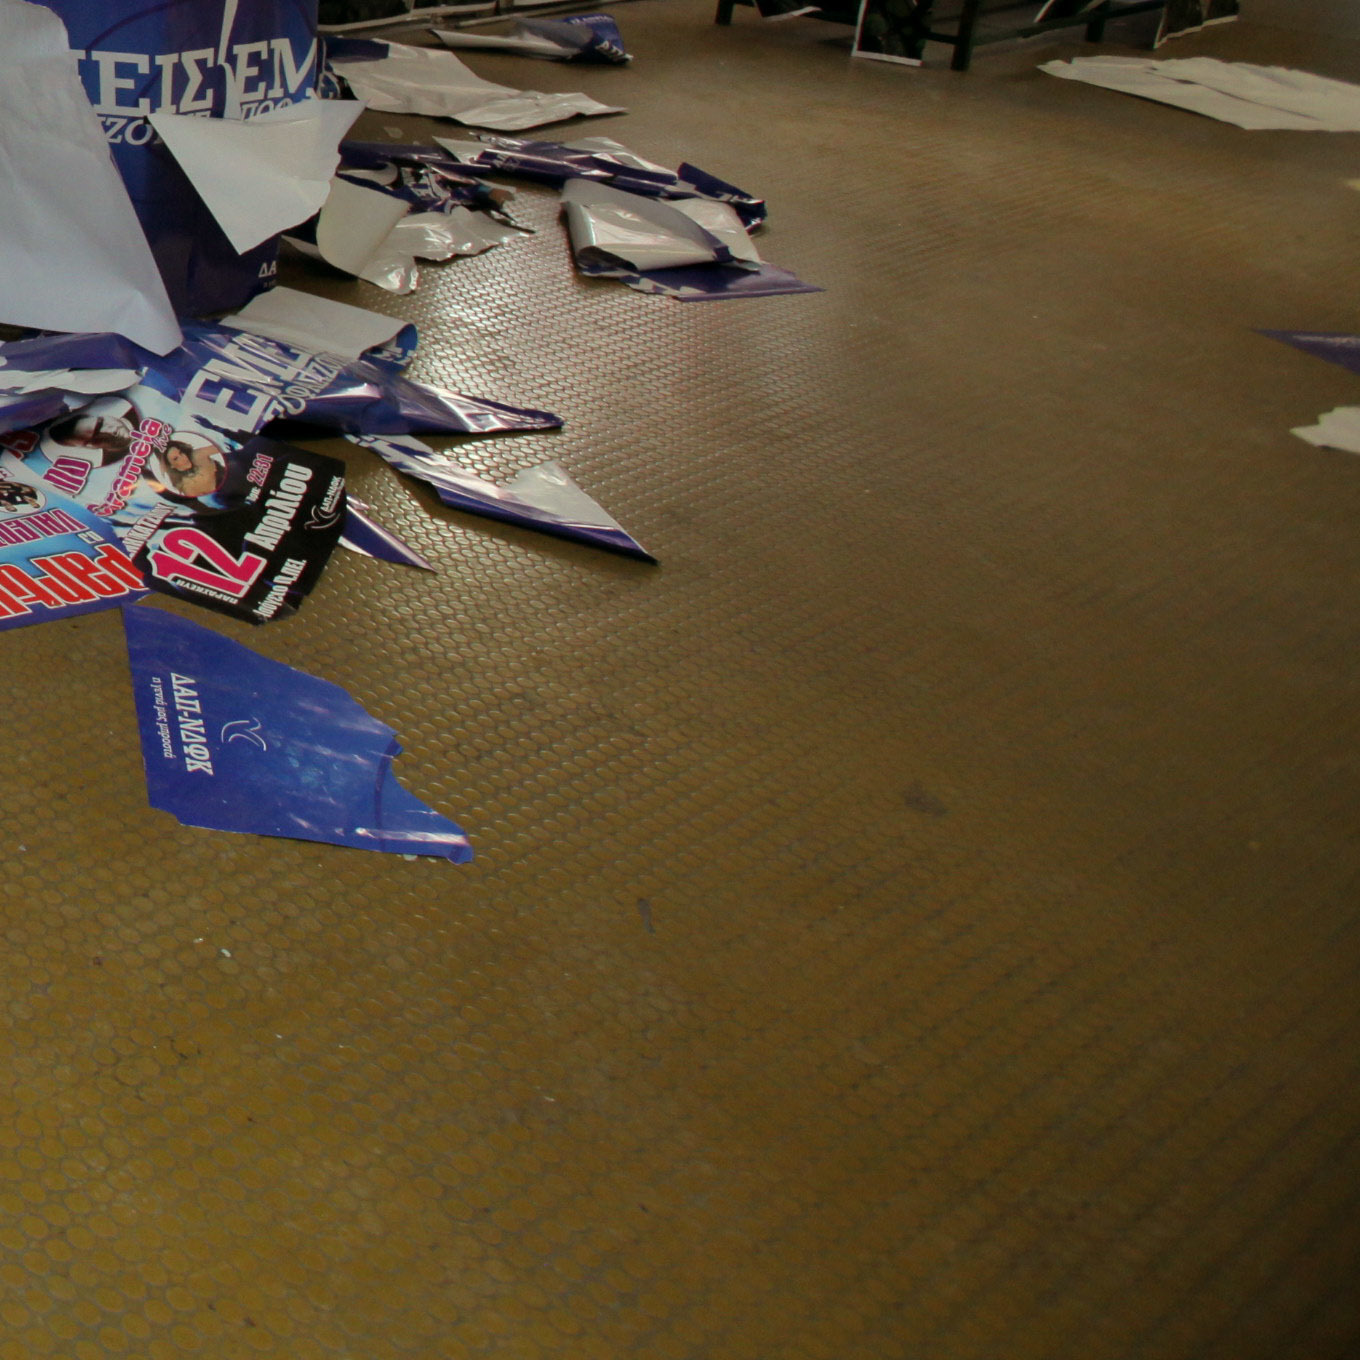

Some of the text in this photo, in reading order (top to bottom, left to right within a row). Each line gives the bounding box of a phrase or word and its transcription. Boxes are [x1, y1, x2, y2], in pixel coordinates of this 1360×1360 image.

[246, 453, 274, 487] 22:31
[147, 462, 313, 598] 12 Απριλίου
[171, 672, 214, 776] ΔΑΠ-ΝΔΦΚ
